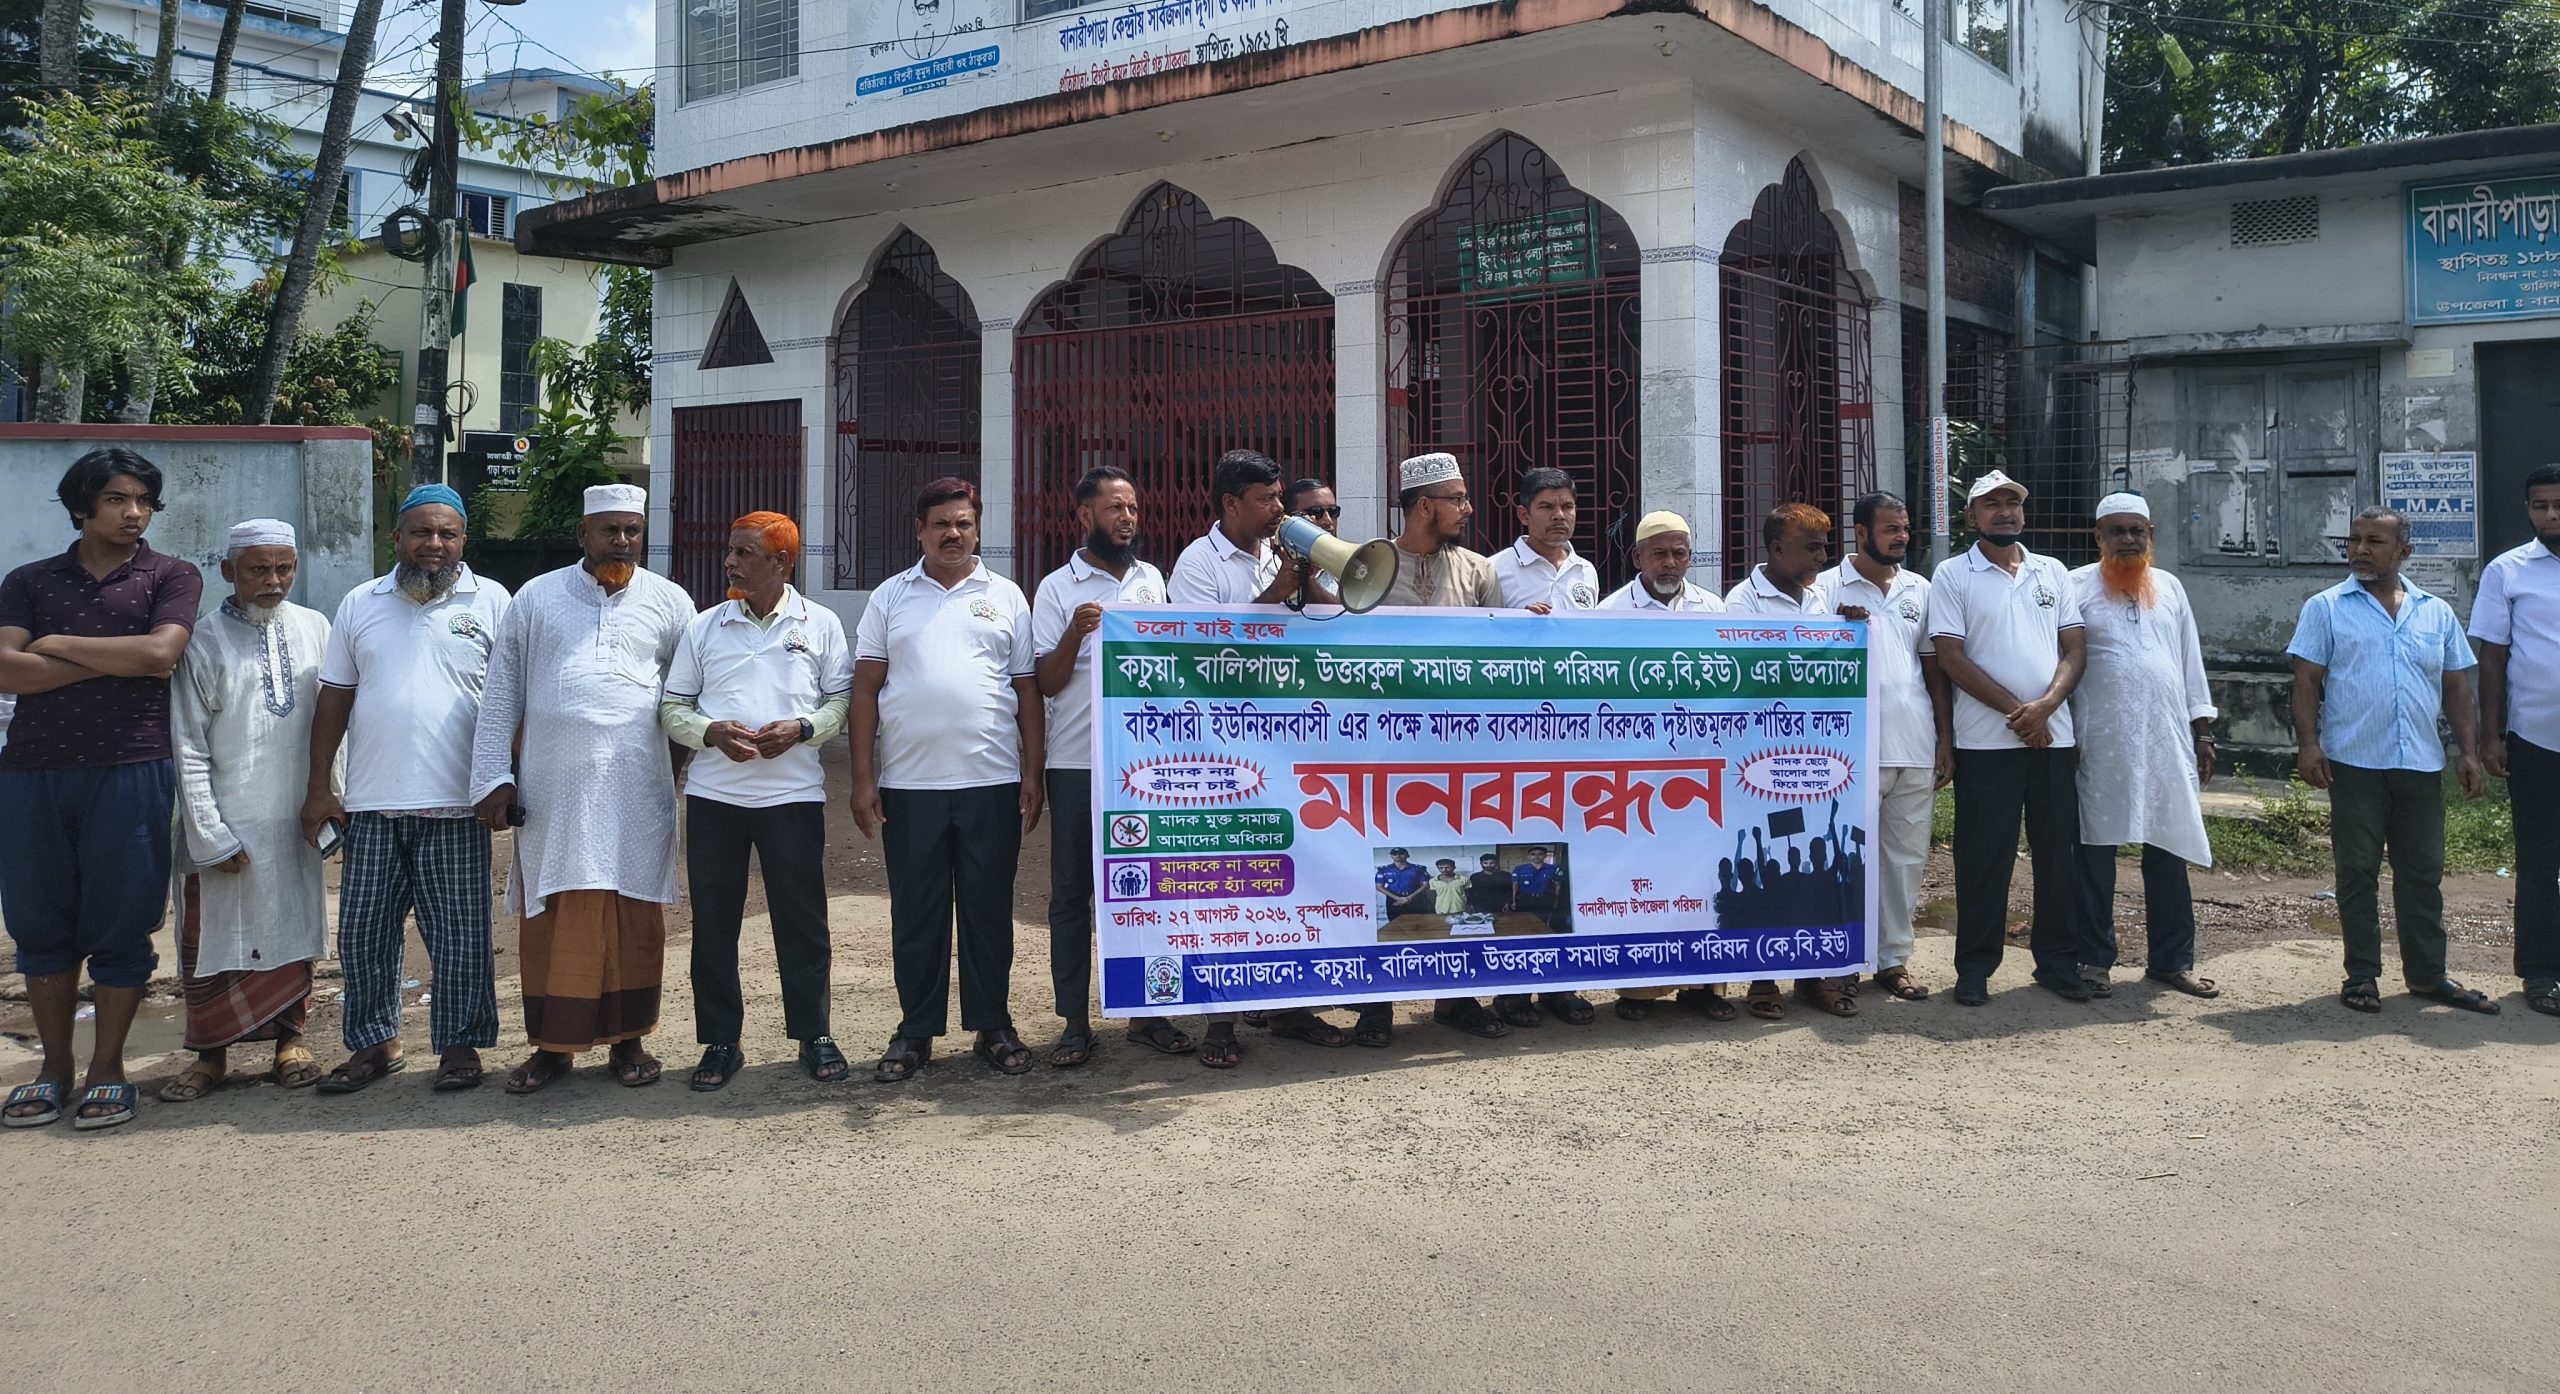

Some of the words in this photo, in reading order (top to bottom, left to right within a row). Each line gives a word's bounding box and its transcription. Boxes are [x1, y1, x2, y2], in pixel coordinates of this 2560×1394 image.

[1059, 16, 1108, 52] বানারীপাড়া
[1112, 4, 1144, 40] কেন্দ্রীয়
[2419, 185, 2560, 243] বানারীপাড়া
[2437, 299, 2508, 312] উপজেলা
[1134, 619, 1185, 638] চলো
[1196, 618, 1235, 638] যাই
[1243, 621, 1287, 641] যুদ্ধে
[1716, 627, 1787, 642] মাদকের
[1792, 625, 1855, 643] বিরুদ্ধে
[1116, 653, 1185, 690] কচুয়া,
[1195, 648, 1306, 690] বালিপাড়া,
[1315, 649, 1405, 694] উত্তরকুল
[1410, 657, 1473, 685] সমাজ
[1477, 656, 1545, 686] কল্যাণ
[1554, 651, 1621, 686] পরিষদ
[1751, 657, 1781, 684] এর
[1788, 652, 1861, 687] উদ্যোগে
[1123, 701, 1203, 746] বাইশারী
[1209, 700, 1332, 744] ইউনিয়নবাসী
[1338, 711, 1369, 743] এর
[1376, 709, 1422, 743] পক্ষে
[1428, 711, 1480, 743] মাদক
[1485, 701, 1594, 743] ব্যবসায়ীদের
[1597, 702, 1658, 741] বিরুদ্ধে
[1662, 702, 1751, 752] দৃষ্টান্তমূলক
[1754, 701, 1806, 739] শাস্তির
[1812, 710, 1852, 739] লক্ষ্যে
[1772, 758, 1802, 766] মাদক
[1806, 758, 1828, 766] ছেড়ে
[1152, 767, 1204, 778] মাদক
[1209, 766, 1237, 778] নয়
[1812, 769, 1830, 777] পথে
[1150, 778, 1199, 792] জীবন
[1206, 777, 1240, 792] চাই
[1772, 779, 1798, 788] ফিরে
[1801, 781, 1828, 790] আসুন
[1293, 759, 1726, 838] মানববন্ধন
[1159, 815, 1200, 827] মাদক
[1204, 814, 1233, 829] মুক্ত
[1238, 813, 1282, 825] সমাজ
[1156, 834, 1220, 847] আমাদের
[1225, 830, 1284, 845] অধিকার
[1159, 860, 1221, 874] মাদককে
[1225, 859, 1242, 872] না
[1247, 859, 1282, 873] বলুন
[1157, 878, 1219, 894] জীবনকে
[1224, 876, 1246, 893] হ্যাঁ
[1250, 879, 1285, 893] বলুন
[1631, 877, 1652, 895] স্থান:
[1112, 906, 1161, 927] তারিখ:
[1169, 911, 1189, 927] ২৭
[1194, 904, 1240, 924] আগস্ট
[1245, 907, 1291, 924] ২০২৬,
[1296, 900, 1368, 928] বৃস্পতিবার,
[1578, 897, 1628, 917] বানারীপাড়া
[1630, 897, 1669, 913] উপজেলা
[1167, 934, 1204, 949] সময়:
[1210, 930, 1249, 947] সকাল
[1256, 931, 1301, 946] ১০:০০
[1306, 926, 1321, 943] টা
[1191, 957, 1304, 989] আয়োজনে:
[1311, 954, 1373, 989] কচুয়া,
[1379, 947, 1476, 980] বালিপাড়া,
[1481, 943, 1560, 977] উত্তরকুল
[1566, 943, 1621, 968] সমাজ
[1626, 938, 1683, 965] কল্যাণ
[1690, 931, 1750, 961] পরিষদ
